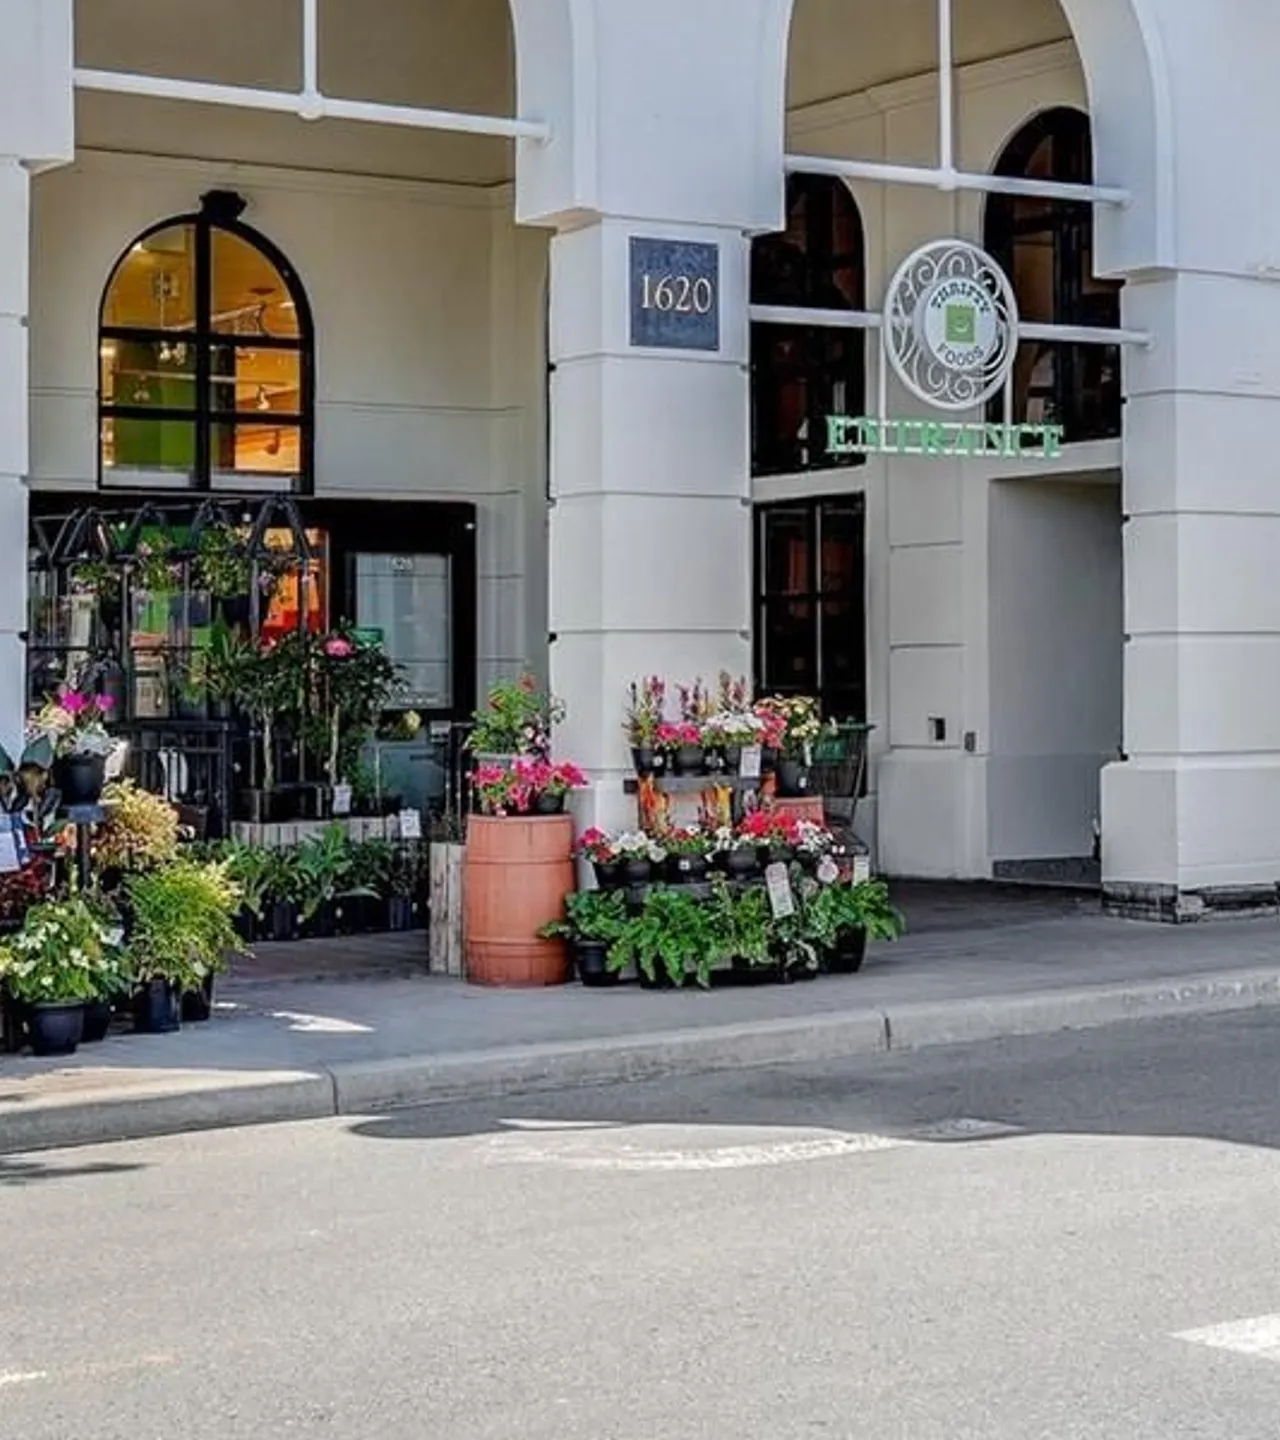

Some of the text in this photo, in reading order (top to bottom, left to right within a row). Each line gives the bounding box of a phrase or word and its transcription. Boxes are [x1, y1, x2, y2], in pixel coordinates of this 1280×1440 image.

[641, 273, 712, 314] 1620
[929, 280, 992, 314] THRIFTY
[936, 343, 986, 368] FOODS
[824, 413, 1064, 459] ENTRANCE
